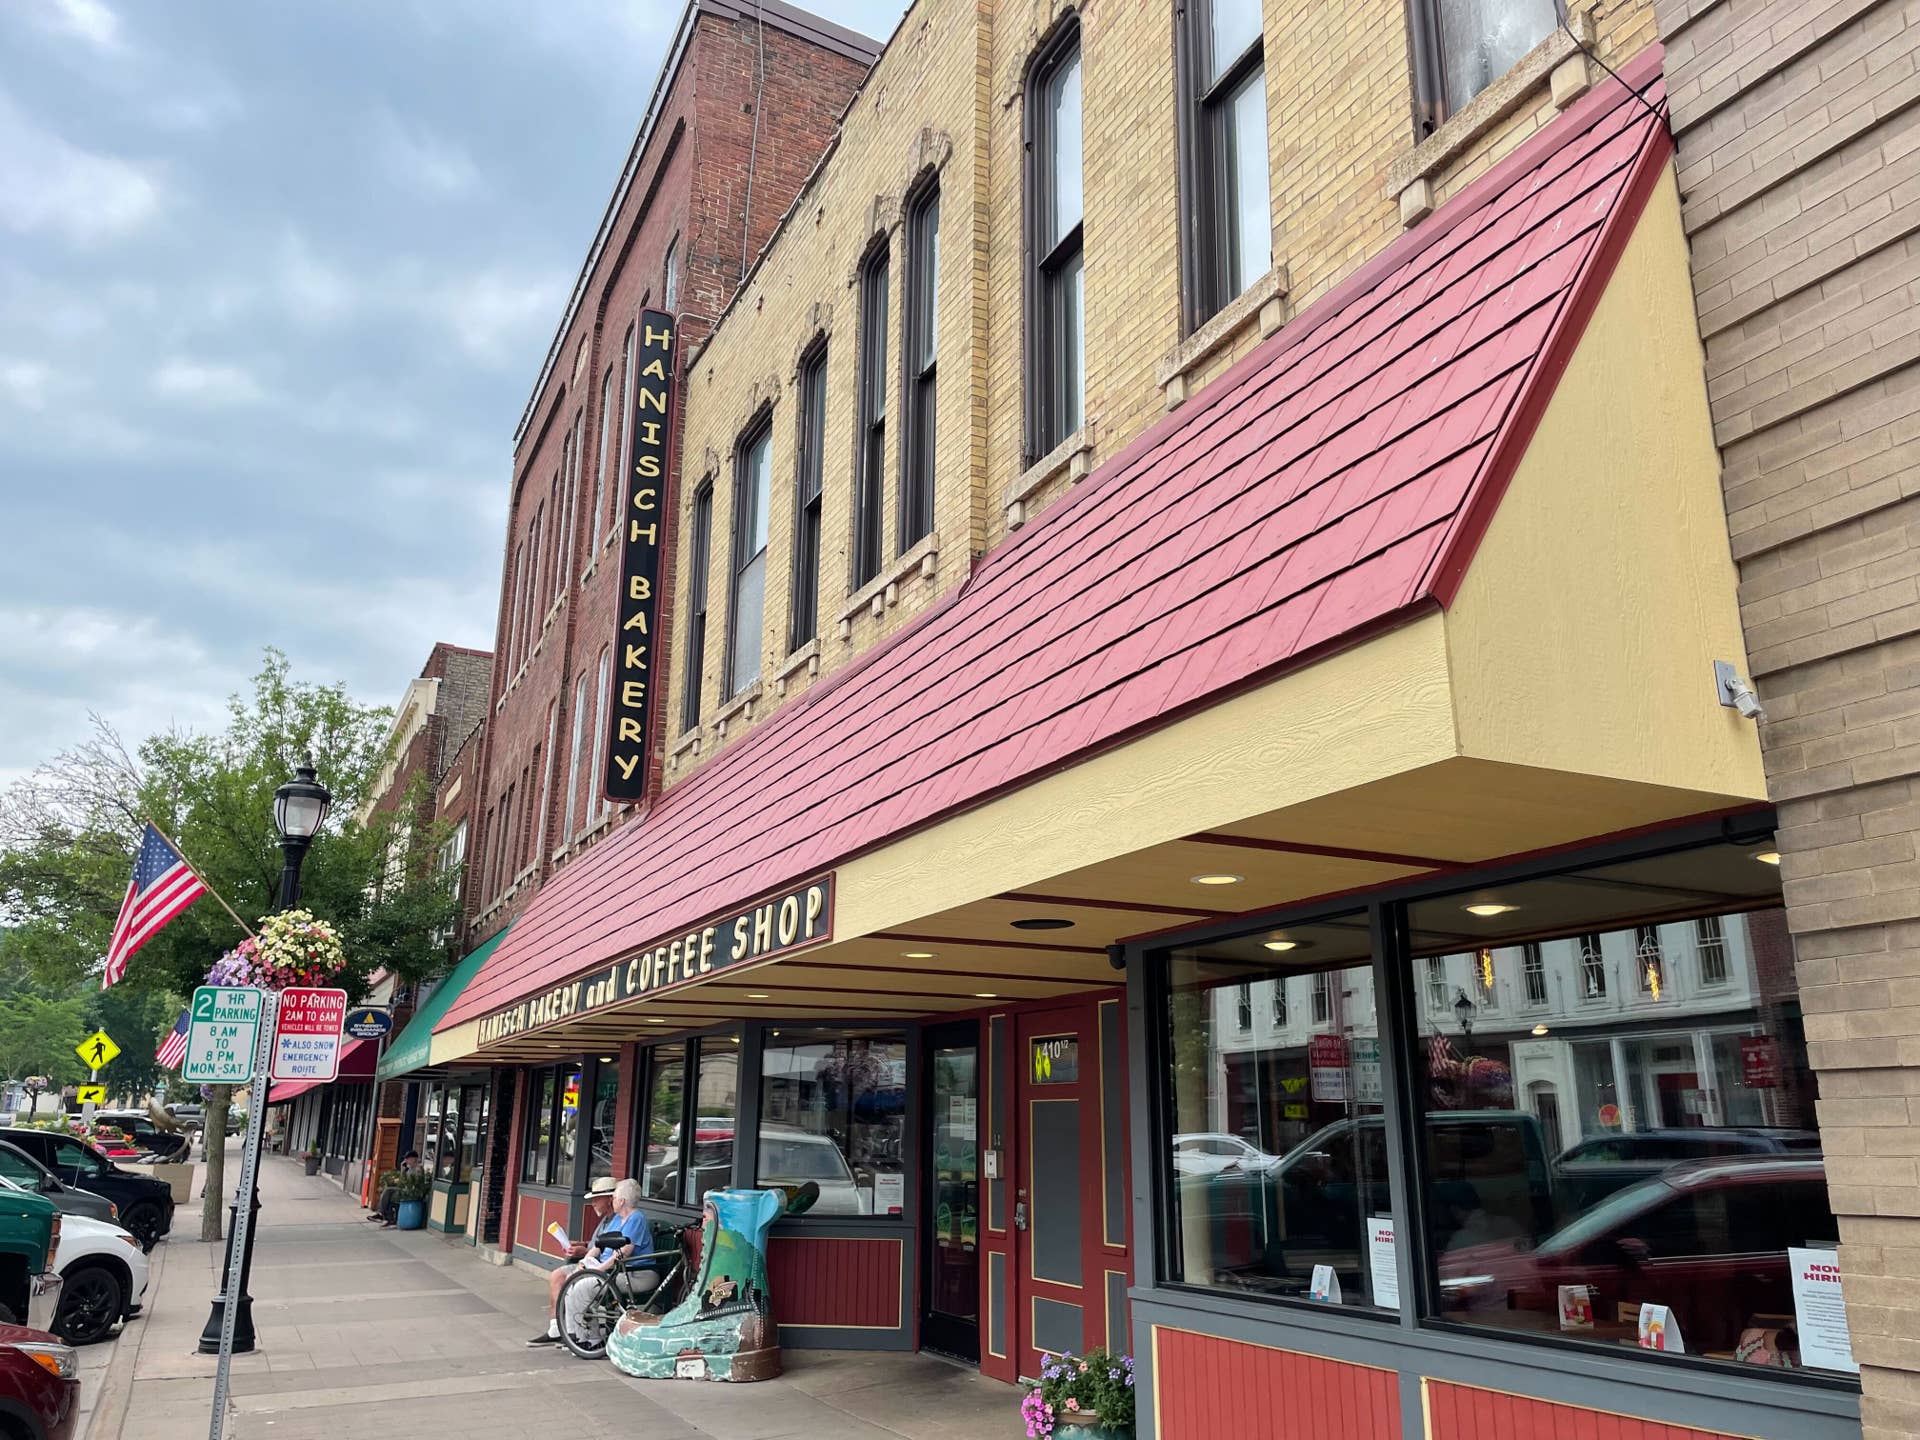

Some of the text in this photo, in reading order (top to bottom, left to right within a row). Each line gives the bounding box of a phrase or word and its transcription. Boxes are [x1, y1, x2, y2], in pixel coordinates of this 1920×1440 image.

[614, 325, 669, 780] HANISCH BAKERY
[479, 886, 822, 1044] HANISCH BAKERY and COFFEE SHOP
[228, 993, 246, 1005] HR
[282, 994, 344, 1009] NO PARKING
[196, 994, 213, 1017] 2
[215, 1007, 256, 1020] PARKING
[285, 1010, 338, 1022] 2AM TO 6AM
[210, 1026, 238, 1037] 8 AM
[216, 1038, 229, 1049] TO
[292, 1040, 335, 1050] ALSO SNOW
[206, 1051, 234, 1062] 8 PM
[282, 1053, 329, 1061] EMERGENCY
[291, 1065, 317, 1073] ROUTE
[1804, 1273, 1841, 1283] HIRI
